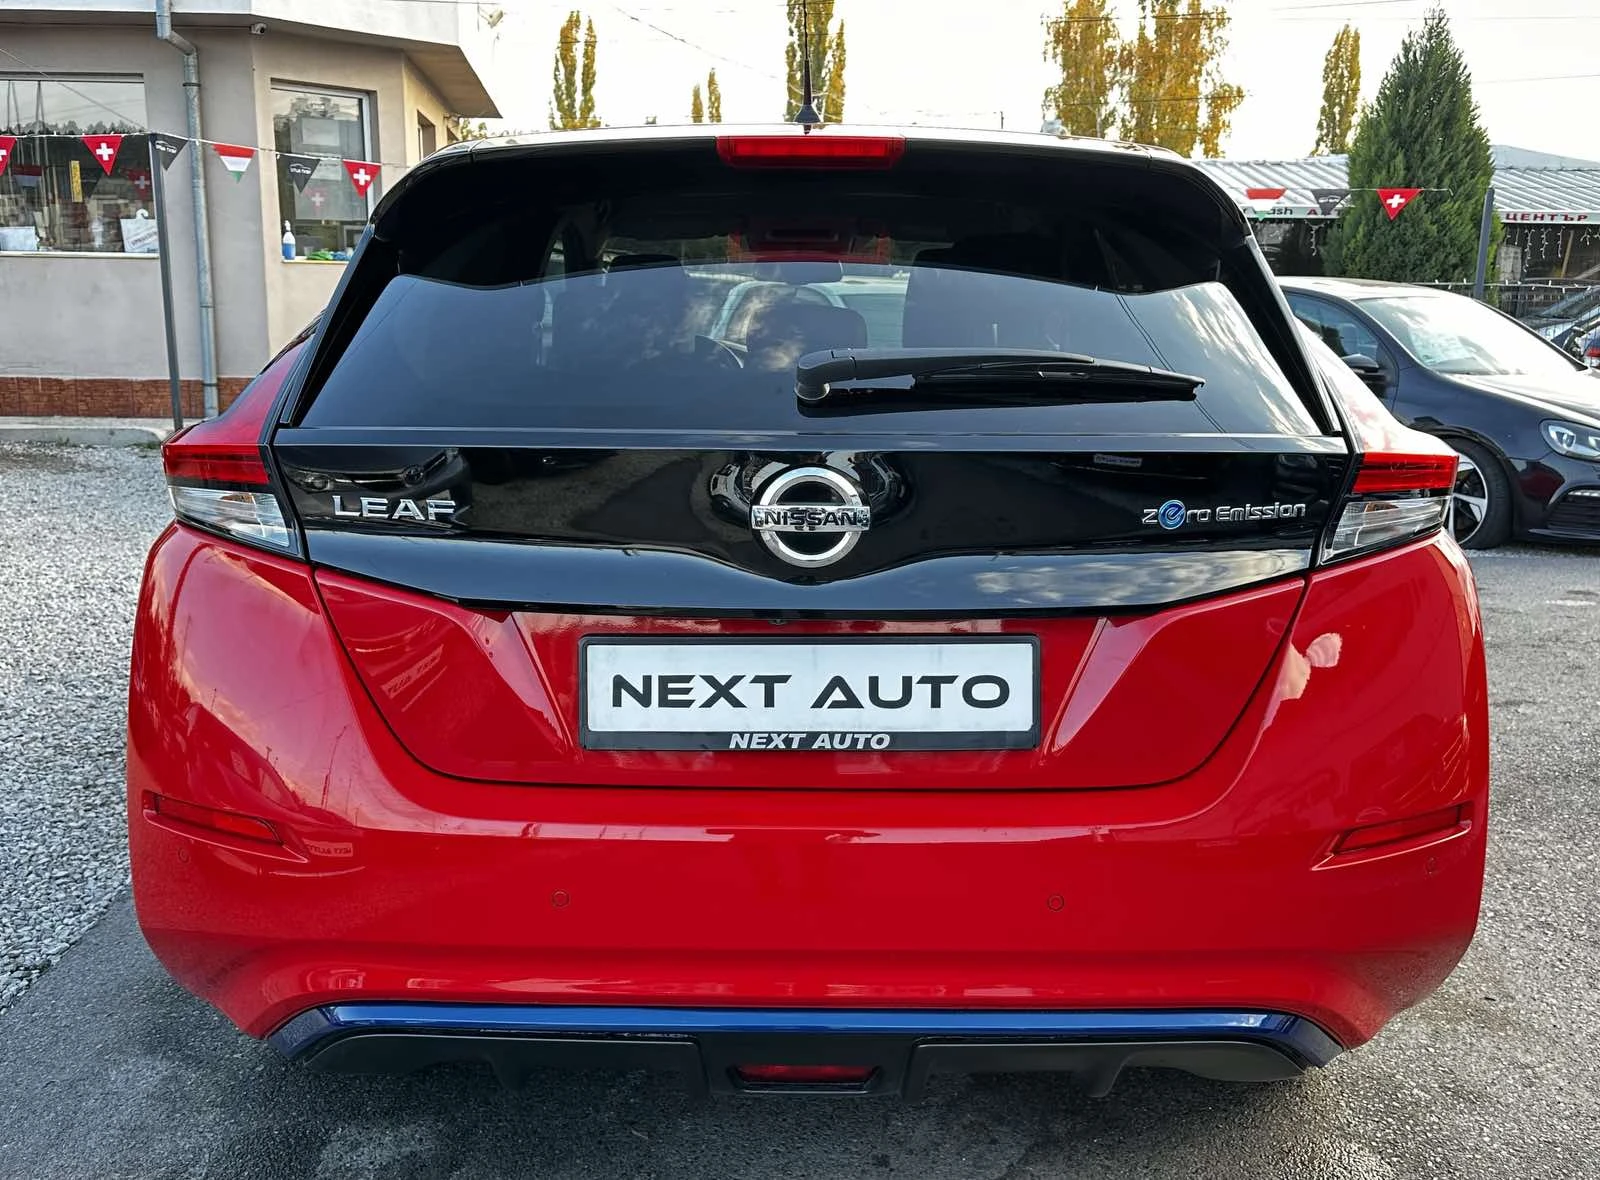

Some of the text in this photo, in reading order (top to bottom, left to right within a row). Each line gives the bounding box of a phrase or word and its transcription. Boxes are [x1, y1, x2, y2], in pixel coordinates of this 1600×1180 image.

[1505, 212, 1588, 222] ЦЕНТЪР
[332, 495, 456, 520] LEAF
[1216, 502, 1306, 522] Emission
[764, 511, 857, 525] NISSAN
[612, 674, 1010, 709] NEXT AUTO
[729, 733, 890, 749] NEXT AUTO
